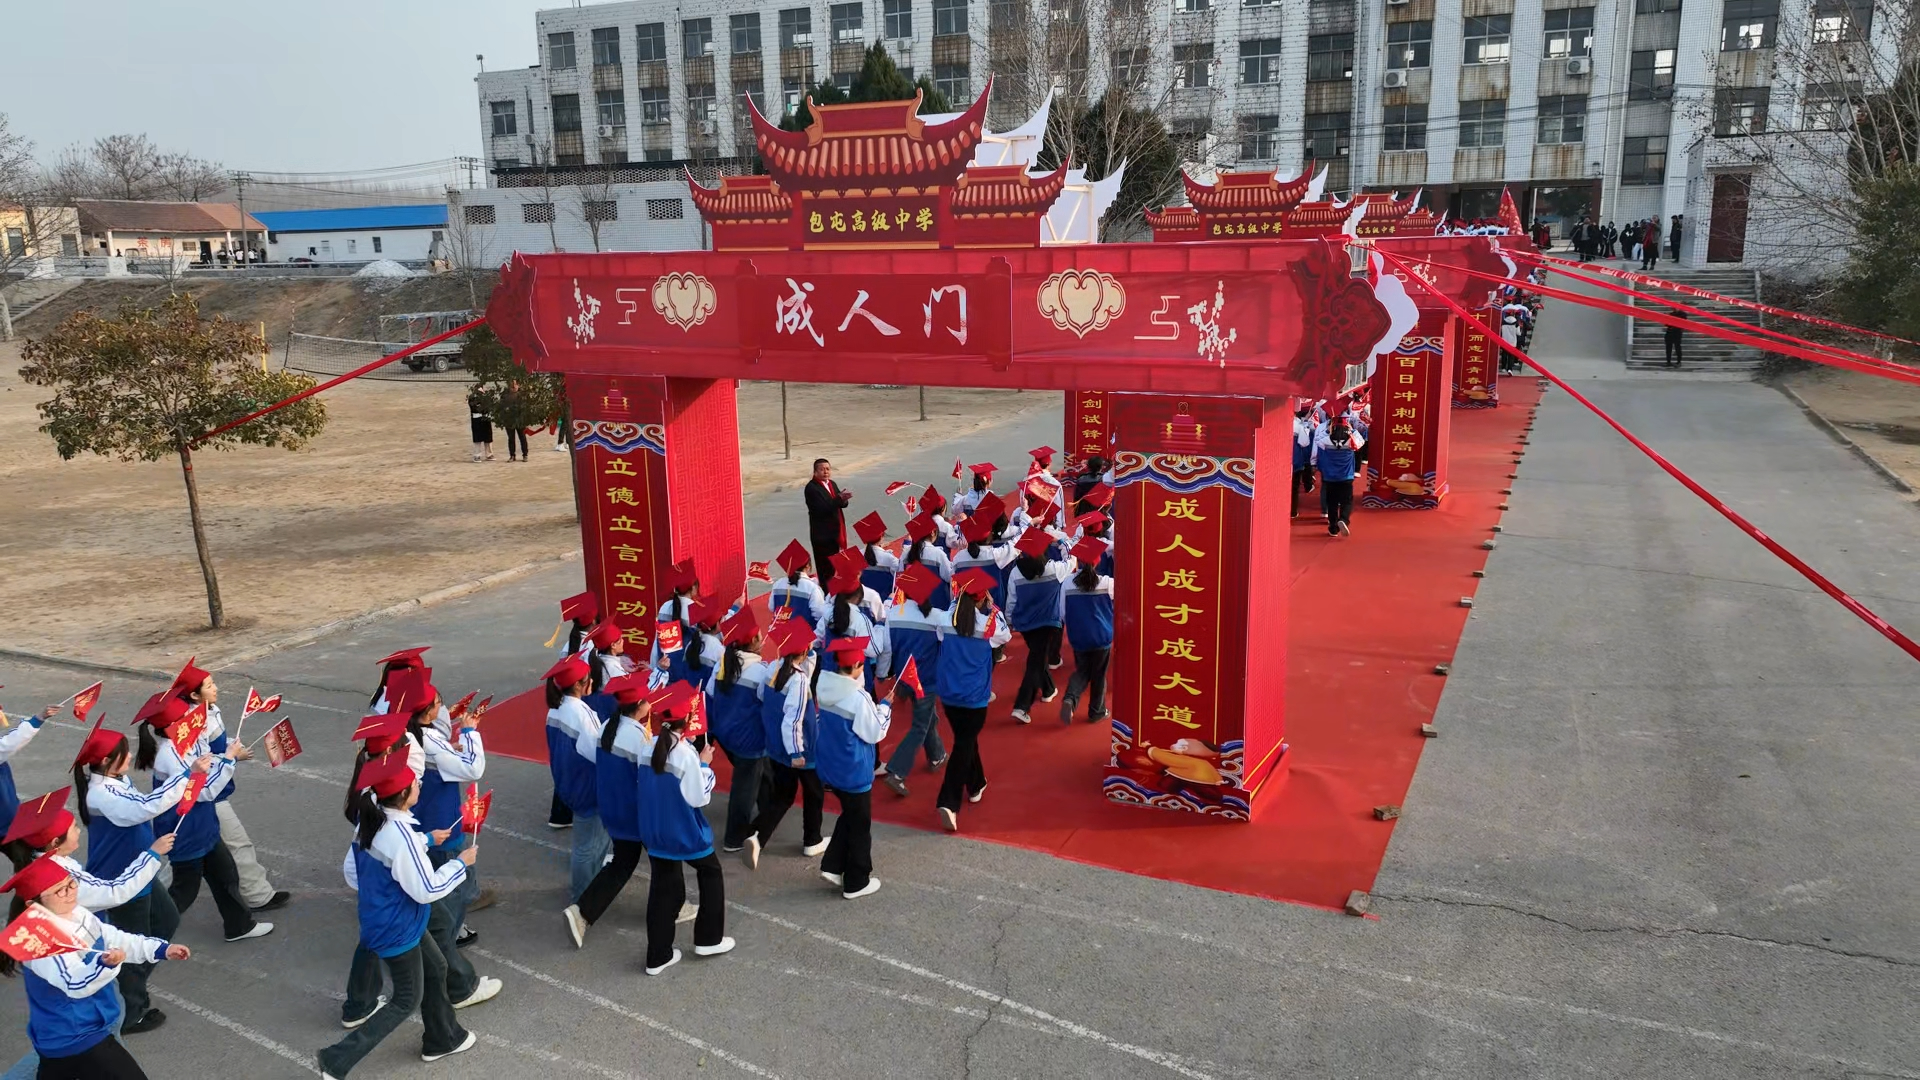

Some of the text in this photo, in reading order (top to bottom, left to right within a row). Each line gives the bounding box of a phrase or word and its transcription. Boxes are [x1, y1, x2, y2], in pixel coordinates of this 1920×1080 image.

[810, 207, 934, 233] 包屯高级中学
[1213, 222, 1283, 235] 包屯高级中学
[1356, 225, 1396, 235] 屯高级中学
[776, 278, 968, 347] 成人门
[1465, 313, 1487, 384] 十而志正青春
[1082, 390, 1103, 454] 剑试锋芒
[1390, 356, 1420, 468] 百日冲刺战高考
[604, 457, 648, 646] 立德立言立功名
[1152, 497, 1207, 730] 成人成才成大道
